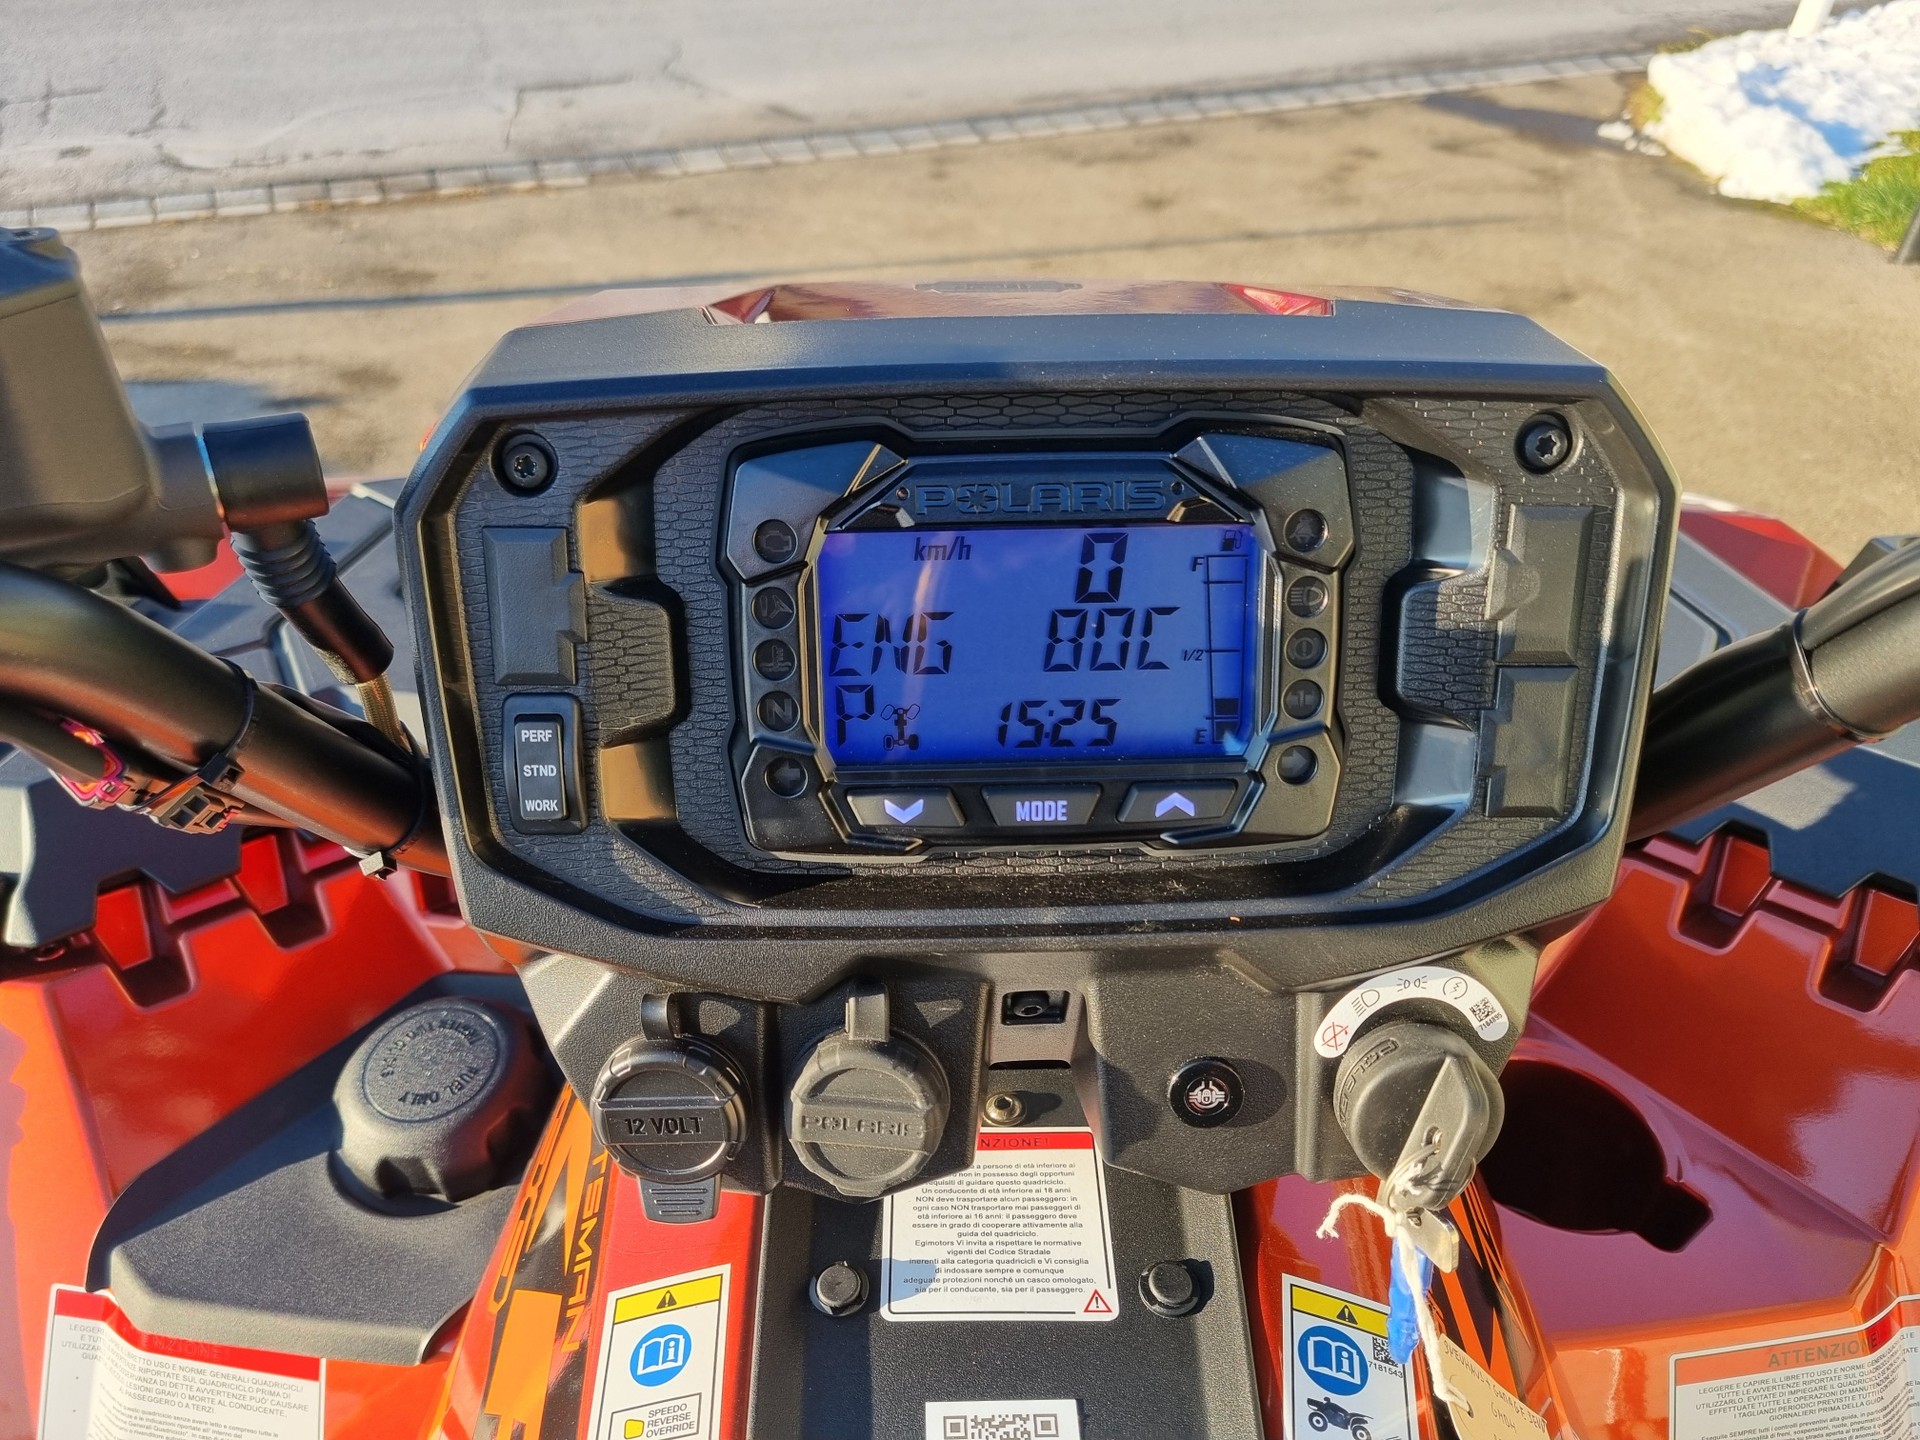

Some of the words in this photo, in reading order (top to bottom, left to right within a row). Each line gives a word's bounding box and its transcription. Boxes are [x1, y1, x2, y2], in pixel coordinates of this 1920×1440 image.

[914, 480, 1166, 516] POLARIS
[913, 537, 971, 562] km/h
[1075, 532, 1128, 603] 0
[1192, 557, 1203, 572] F
[829, 611, 954, 676] ENG
[1181, 649, 1204, 662] 1/2
[836, 684, 874, 747] P
[997, 698, 1121, 749] 15:25
[521, 730, 552, 742] PERF
[1195, 728, 1206, 745] E
[523, 765, 557, 777] STND
[525, 800, 559, 812] WORK
[1015, 801, 1068, 822] MODE
[624, 1118, 647, 1136] 12
[651, 1117, 704, 1136] VOLT
[802, 1115, 925, 1138] POLARIS
[1030, 1204, 1072, 1212] passeggeri
[957, 1230, 978, 1238] guida
[994, 1230, 1038, 1238] quadriciclo.
[915, 1239, 954, 1247] Egimotors
[995, 1239, 1032, 1247] rispettare
[909, 1258, 938, 1266] inerenti
[1053, 1258, 1088, 1266] consiglia
[935, 1266, 942, 1275] di
[903, 1276, 940, 1284] adeguate
[942, 1276, 982, 1284] protezioni
[928, 1285, 941, 1294] per
[1368, 1360, 1404, 1379] 7181543
[178, 1366, 207, 1376] NORME
[209, 1371, 250, 1383] GENERALI
[251, 1378, 303, 1392] QUADRICICLI
[1698, 1383, 1734, 1394] LEGGERE
[1742, 1378, 1770, 1388] CAPIRE
[1779, 1371, 1816, 1382] LIBRETTO
[1815, 1368, 1832, 1377] USO
[1838, 1363, 1868, 1373] NORME
[1716, 1390, 1740, 1399] TUTTE
[1752, 1381, 1800, 1394] AVVERTENZE
[1802, 1375, 1842, 1386] RIPORTATE
[1843, 1373, 1860, 1381] SUL
[1747, 1392, 1778, 1402] EVITATE
[1787, 1385, 1827, 1396] IMPIEGARE
[648, 1403, 687, 1419] SPEEDO
[647, 1412, 691, 1428] REVERSE
[646, 1421, 695, 1439] OVERRIDE
